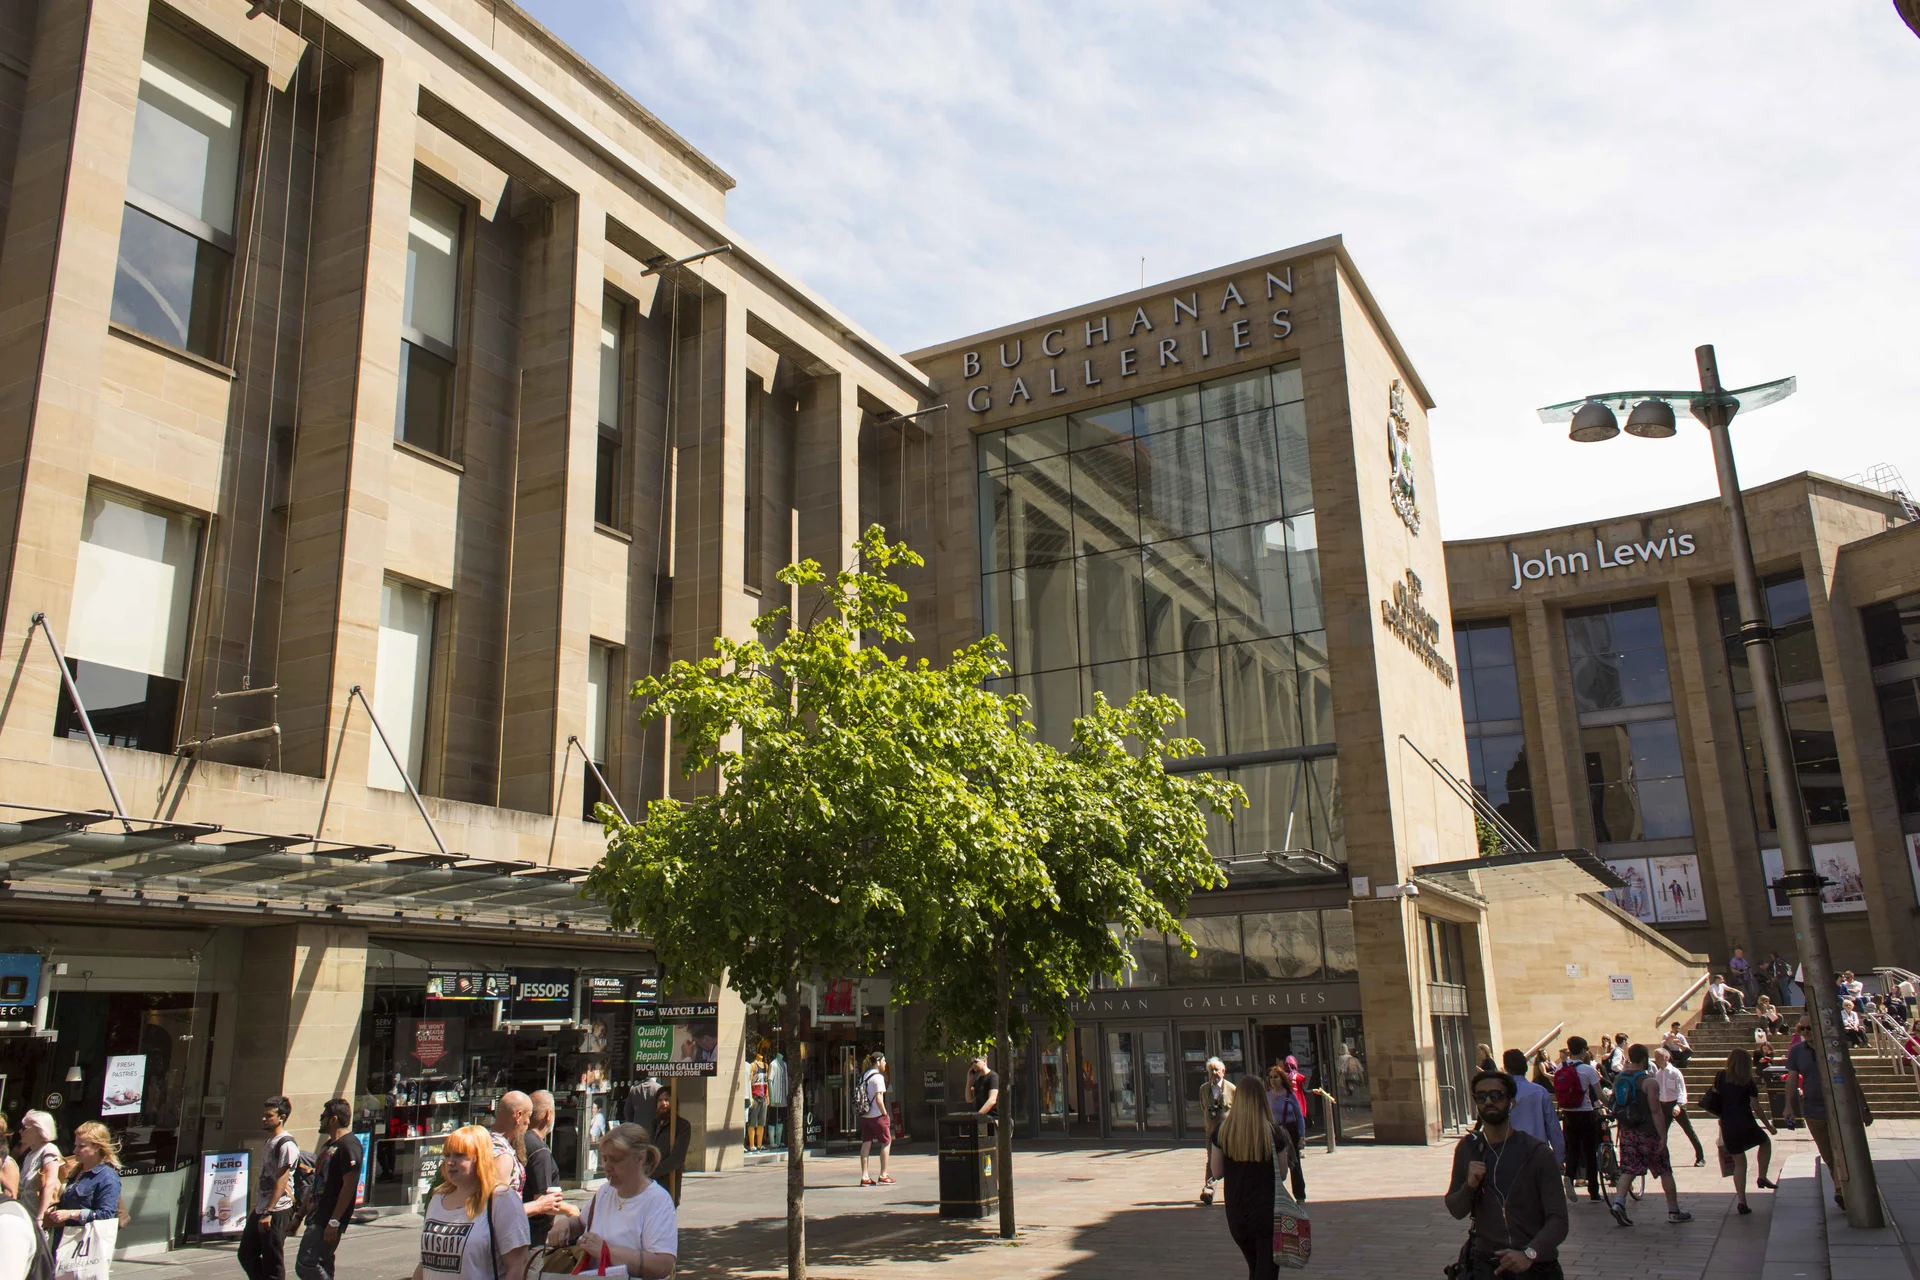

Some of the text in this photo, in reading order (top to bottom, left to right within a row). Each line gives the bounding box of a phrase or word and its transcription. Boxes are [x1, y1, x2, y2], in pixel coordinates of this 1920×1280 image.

[963, 266, 1293, 378] BUCHANAN
[967, 309, 1293, 412] GALLERIES
[1511, 528, 1696, 590] John Lewis
[516, 983, 569, 1001] JESSOPS
[1022, 992, 1326, 1014] BHANAN GALLERIES
[636, 1008, 654, 1017] The
[658, 1006, 695, 1016] WATCH
[638, 1026, 668, 1037] Quality
[640, 1039, 666, 1048] Watch
[636, 1051, 668, 1062] Repairs
[636, 1062, 714, 1071] BUCHANAN GALLERIES
[806, 1125, 821, 1134] LADIES
[147, 1165, 166, 1173] LATTE
[212, 1161, 242, 1169] NERO
[421, 1161, 438, 1171] 25%
[421, 1234, 463, 1253] VISORY
[437, 1256, 458, 1267] CONTENT
